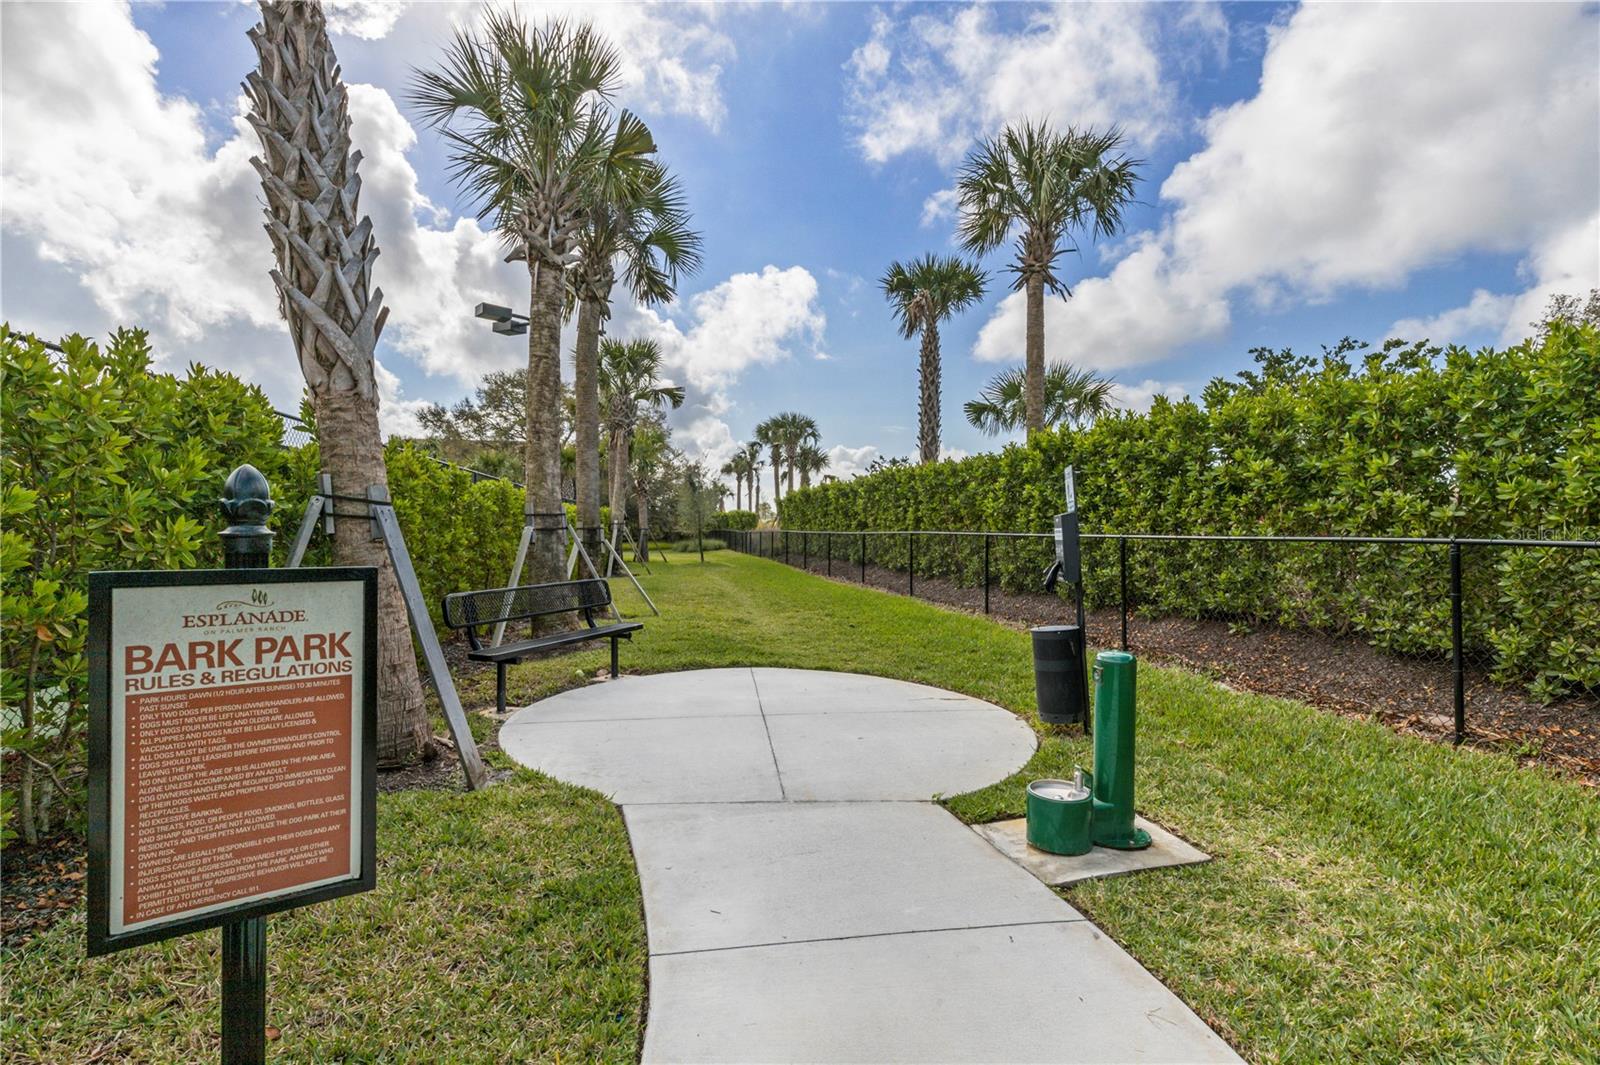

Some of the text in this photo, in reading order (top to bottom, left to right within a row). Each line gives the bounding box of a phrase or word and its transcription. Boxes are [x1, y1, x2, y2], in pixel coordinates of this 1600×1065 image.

[125, 632, 352, 674] BARK PARK
[125, 660, 352, 692] RULES & REGULATIONS
[139, 696, 159, 704] PARK
[161, 693, 187, 702] HOURS:
[188, 691, 211, 699] DAWN
[313, 679, 340, 687] MINUTES
[139, 712, 158, 720] ONLY
[179, 708, 198, 716] DOGS
[214, 703, 241, 712] PERSON
[139, 720, 160, 728] DOGS
[162, 718, 182, 726] MUST
[184, 715, 207, 723] NEVER
[139, 728, 158, 737] ONLY
[160, 726, 180, 734] DOGS
[182, 724, 200, 732] FOUR
[201, 720, 231, 729] MONTHS
[154, 734, 182, 743] PUPPIES
[202, 729, 222, 737] DOGS
[223, 726, 242, 734] MUST
[254, 722, 280, 731] LEGALLY
[281, 718, 310, 727] LICENSED
[139, 761, 160, 770] DOGS
[161, 757, 190, 766] SHOULD
[202, 751, 232, 761] LEASHED
[233, 747, 258, 756] BEFORE
[259, 743, 290, 753] ENTERING
[140, 739, 206, 753] VACCINATED WITH
[154, 751, 174, 759] DOGS
[175, 748, 196, 756] MUST
[208, 743, 231, 752] UNDER
[138, 784, 164, 794] ALONE
[164, 780, 192, 790] UNLESS
[193, 772, 243, 786] ACCOMPANIED
[138, 794, 156, 803] DOG
[158, 783, 227, 800] OWNERS/HANDLERS
[242, 776, 274, 786] REQUIRED
[284, 768, 325, 780] IMMEDIATELY
[326, 764, 345, 773] CLEAN
[139, 767, 169, 778] LEAVING
[152, 776, 166, 784] ONE
[168, 772, 193, 782] UNDER
[249, 760, 280, 770] ALLOWED
[150, 774, 333, 809] THEIR DOGS WASTE AND PROPERLY DISPOSE TRASH
[138, 827, 154, 836] DOG
[218, 811, 242, 821] PEOPLE
[325, 794, 344, 802] GLASS
[151, 813, 189, 825] EXCESSIVE
[138, 839, 177, 852] RESIDENTS
[180, 835, 195, 844] AND
[197, 832, 216, 841] THEIR
[218, 828, 233, 837] PETS
[235, 825, 250, 834] MAY
[252, 821, 275, 831] UTILIZE
[288, 816, 302, 824] DOG
[303, 812, 319, 821] PARK
[330, 808, 346, 816] THEIR
[138, 835, 154, 844] AND
[156, 830, 180, 841] SHARP
[182, 824, 212, 836] OBJECTS
[214, 822, 227, 830] ARE
[228, 819, 242, 827] NOT
[138, 856, 170, 869] OWNERS
[172, 853, 186, 862] ARE
[188, 847, 216, 859] LEGALLY
[217, 838, 261, 853] RESPONSIBLE
[276, 832, 293, 841] THEIR
[295, 829, 311, 837] DOGS
[313, 826, 326, 834] AND
[138, 851, 156, 860] OWN
[137, 880, 171, 894] ANIMALS
[172, 876, 190, 886] WILL
[202, 867, 235, 880] REMOVED
[236, 862, 255, 872] FROM
[289, 849, 317, 861] ANIMALS
[318, 846, 333, 854] WHO
[138, 840, 329, 885] DOGS SHOWING AGGRESSION TOWARDS PEOPLE OTHER
[138, 858, 200, 877] INJURIES CAUSED
[137, 857, 318, 902] EXHIBIT HISTORY AGGRESSIVE BEHAVIOR WILL NOT
[138, 894, 179, 910] PERMITTED
[145, 887, 247, 916] CASE EMERGENCY CALL
